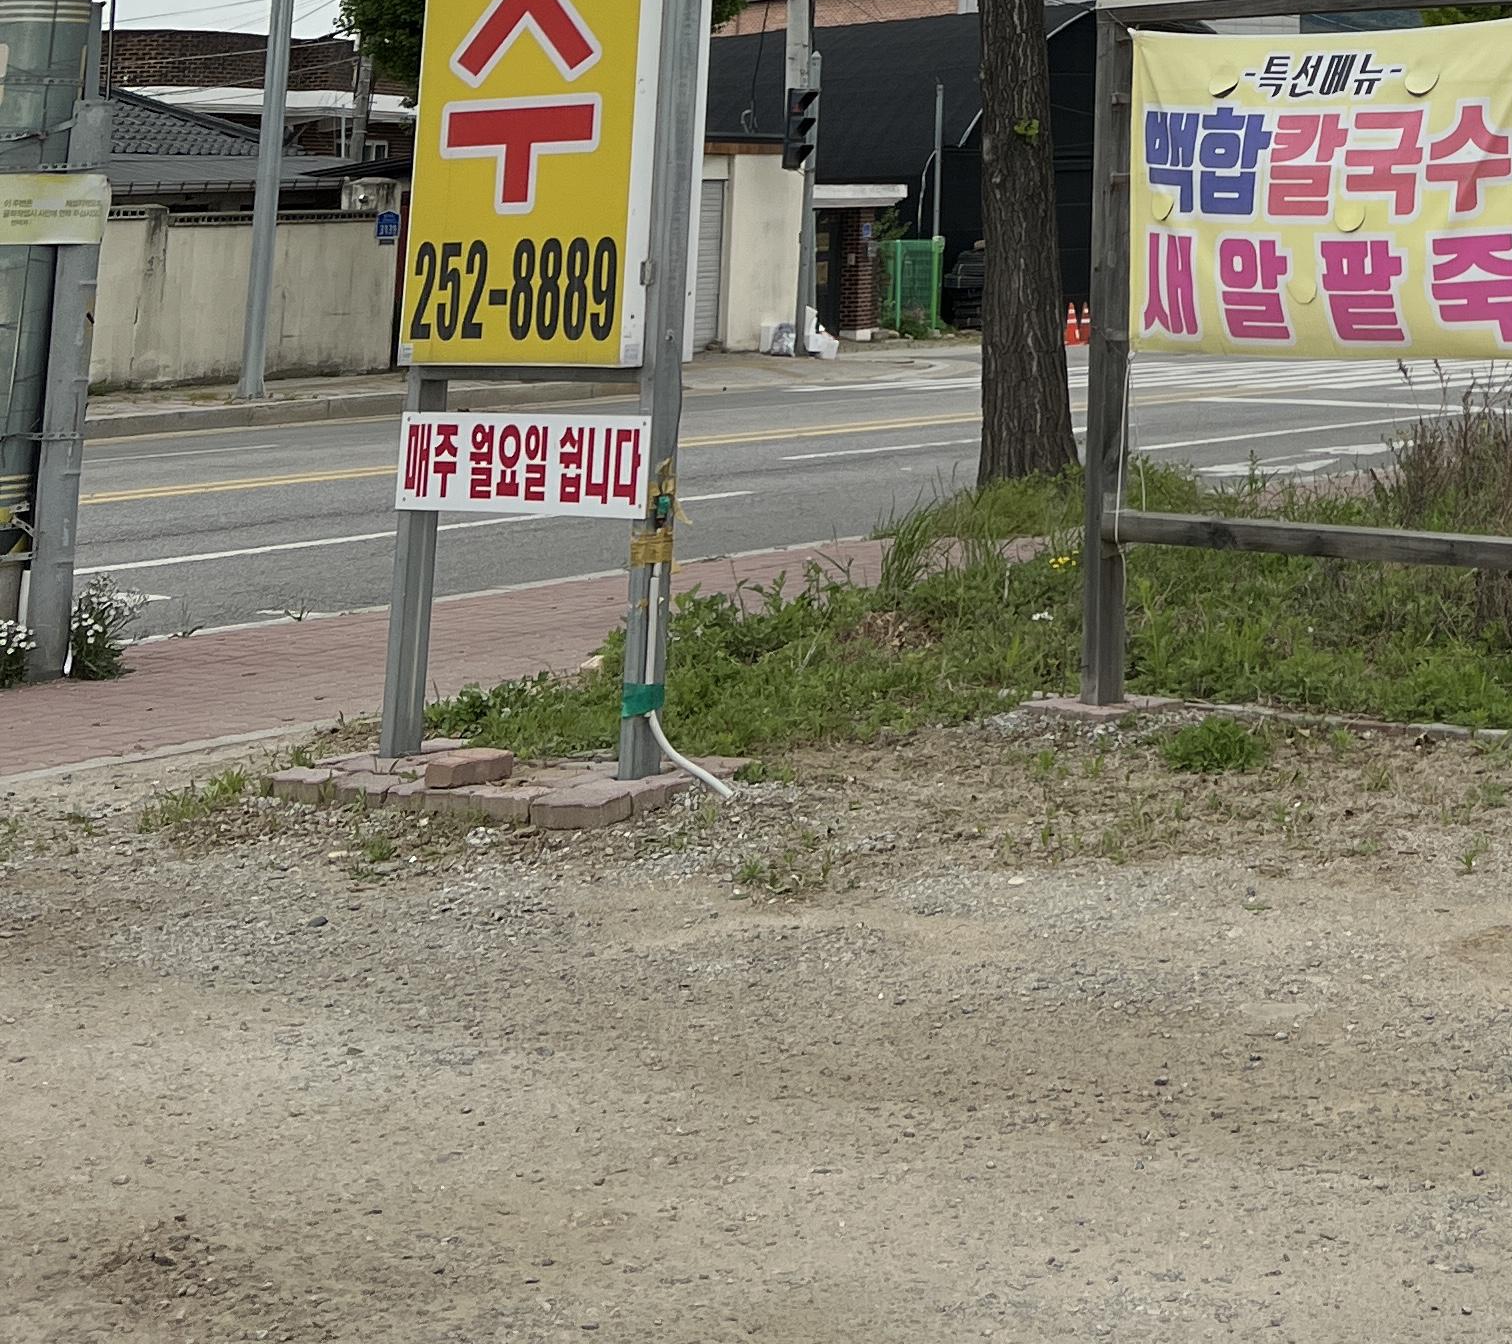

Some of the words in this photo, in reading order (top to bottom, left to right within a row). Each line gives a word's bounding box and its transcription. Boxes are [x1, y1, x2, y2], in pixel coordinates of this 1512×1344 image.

[410, 237, 618, 342] 252-8889
[404, 424, 459, 498] 매주
[469, 424, 549, 502] 월요일
[559, 427, 641, 506] 쉽니다
